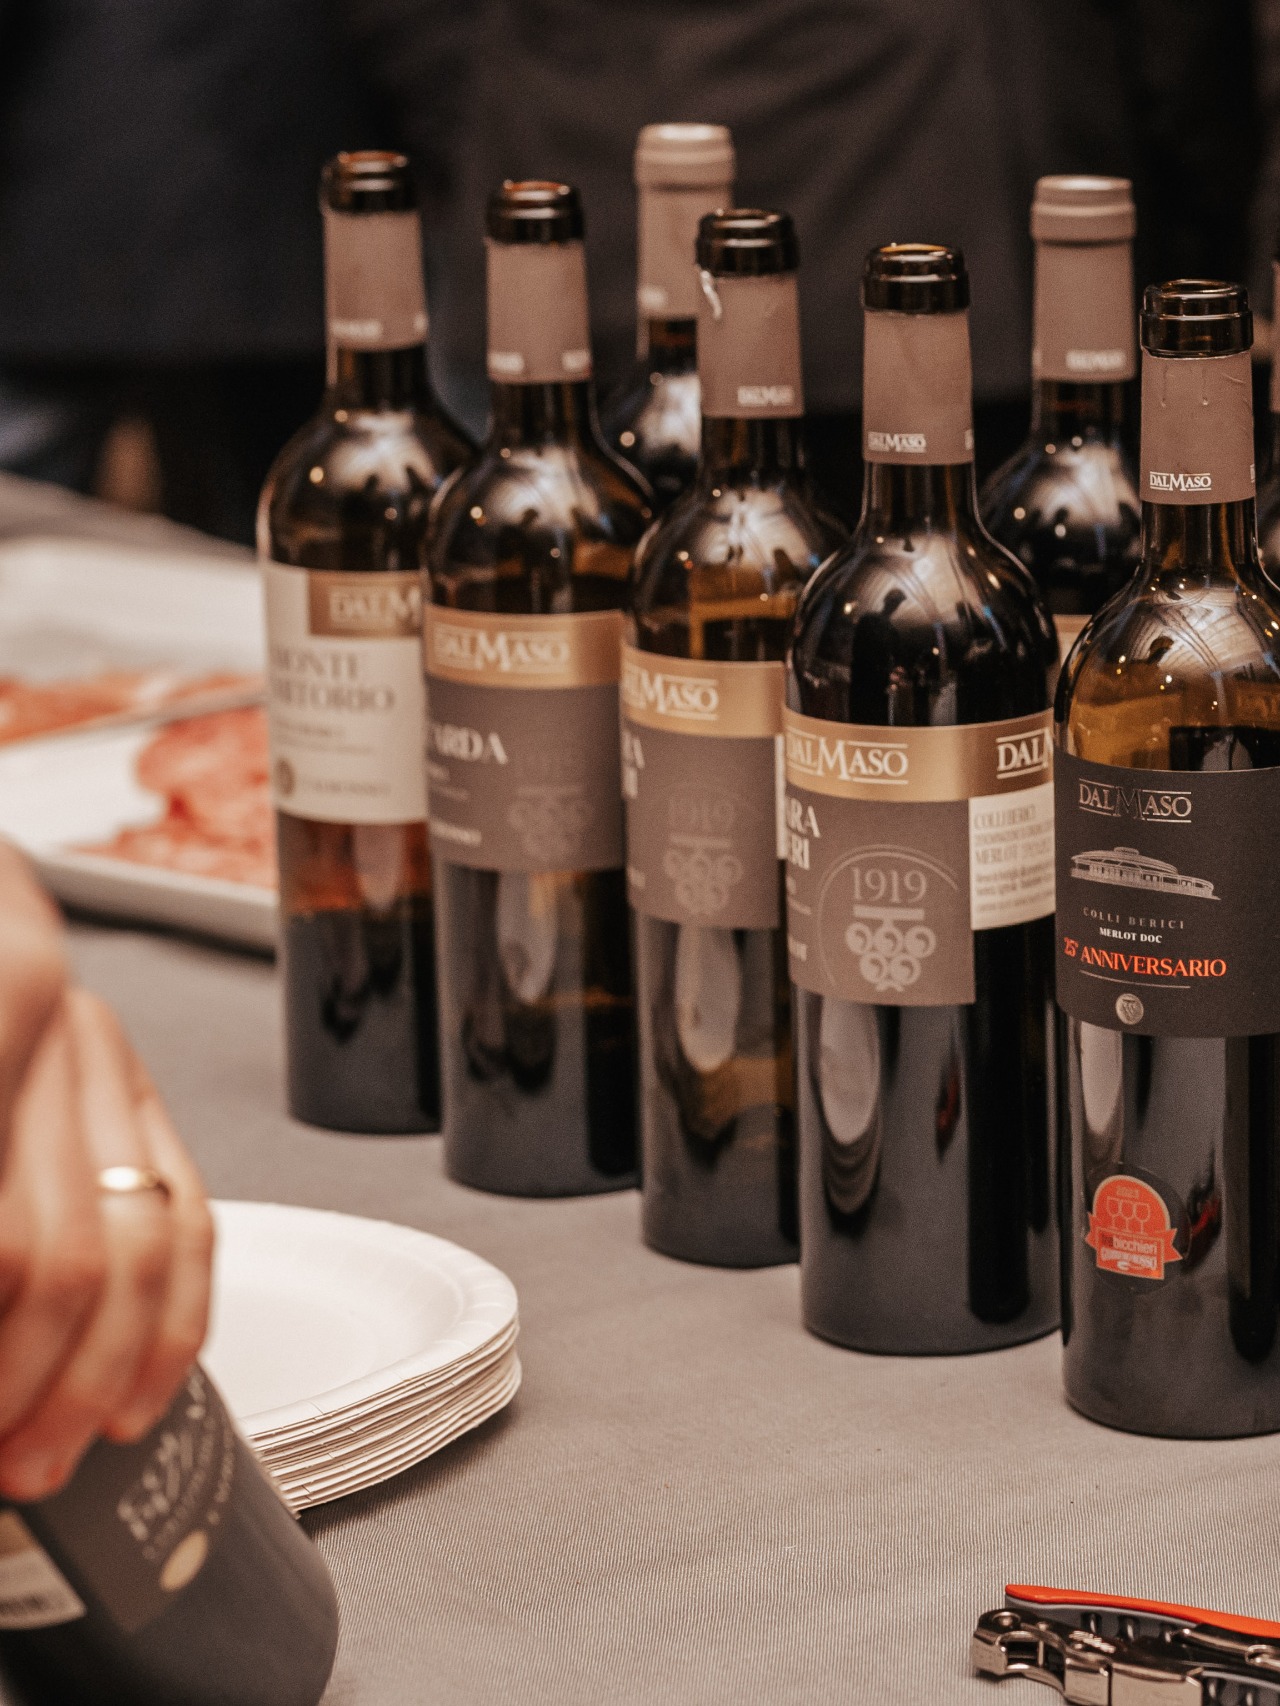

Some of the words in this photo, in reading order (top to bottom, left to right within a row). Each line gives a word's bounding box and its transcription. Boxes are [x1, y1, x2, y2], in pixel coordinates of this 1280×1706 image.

[1150, 472, 1212, 491] DALMASO
[1079, 781, 1192, 822] DALMASO
[852, 866, 927, 904] 1919
[1083, 907, 1120, 924] COLLI
[1128, 916, 1185, 930] BERICI
[1099, 926, 1137, 942] MERLOT
[1140, 933, 1163, 944] DOC
[1080, 949, 1227, 977] ANNIVERSARIO
